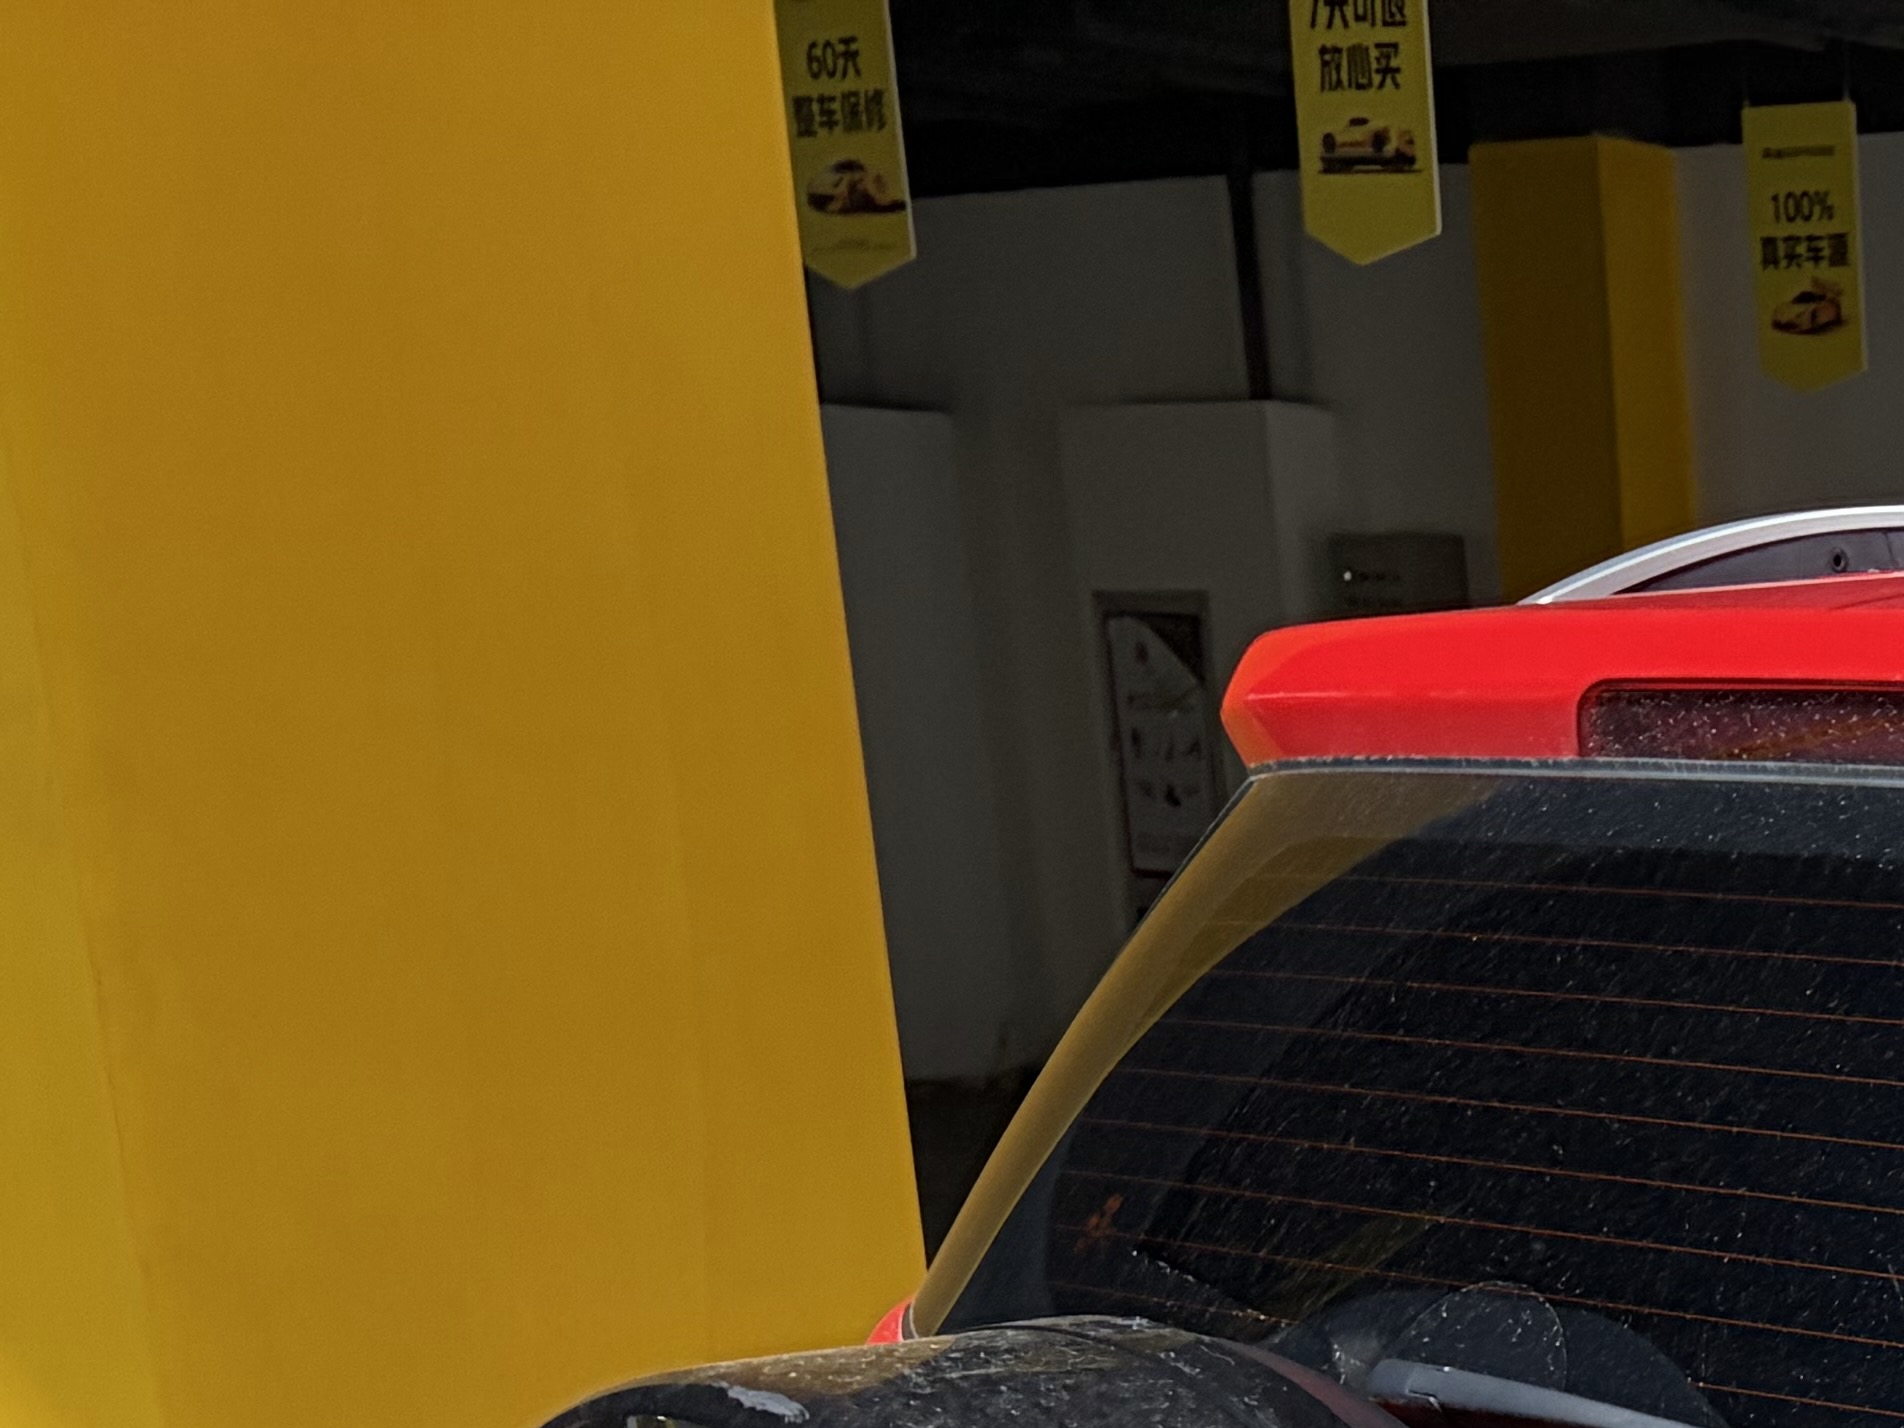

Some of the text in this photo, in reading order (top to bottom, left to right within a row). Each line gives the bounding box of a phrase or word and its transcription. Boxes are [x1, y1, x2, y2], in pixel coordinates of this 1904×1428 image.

[806, 35, 862, 81] 60天
[1318, 42, 1402, 92] 放心买
[1772, 190, 1835, 223] 100%
